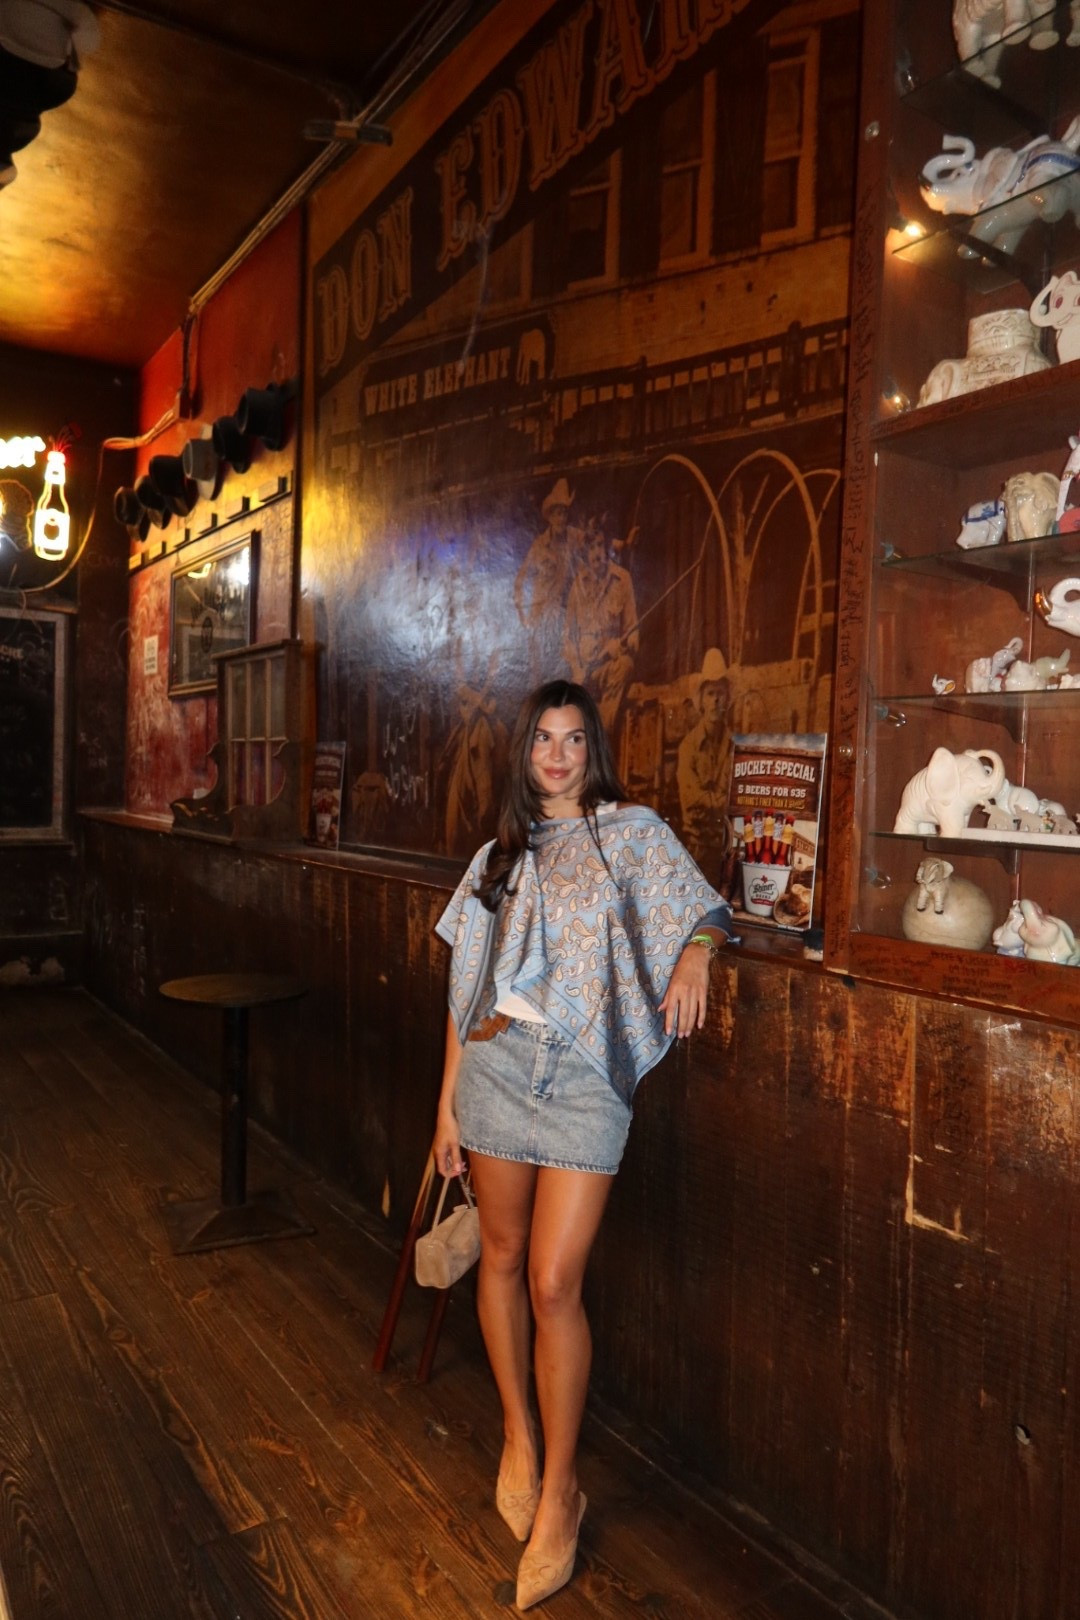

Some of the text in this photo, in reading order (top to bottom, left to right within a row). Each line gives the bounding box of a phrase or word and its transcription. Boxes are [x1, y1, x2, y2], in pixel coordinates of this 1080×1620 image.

[318, 186, 413, 377] DON
[364, 346, 511, 416] WHITE ELEPHANT
[734, 759, 816, 783] BUCKET SPECIAL
[738, 784, 808, 799] 5 BEERS FOR $35
